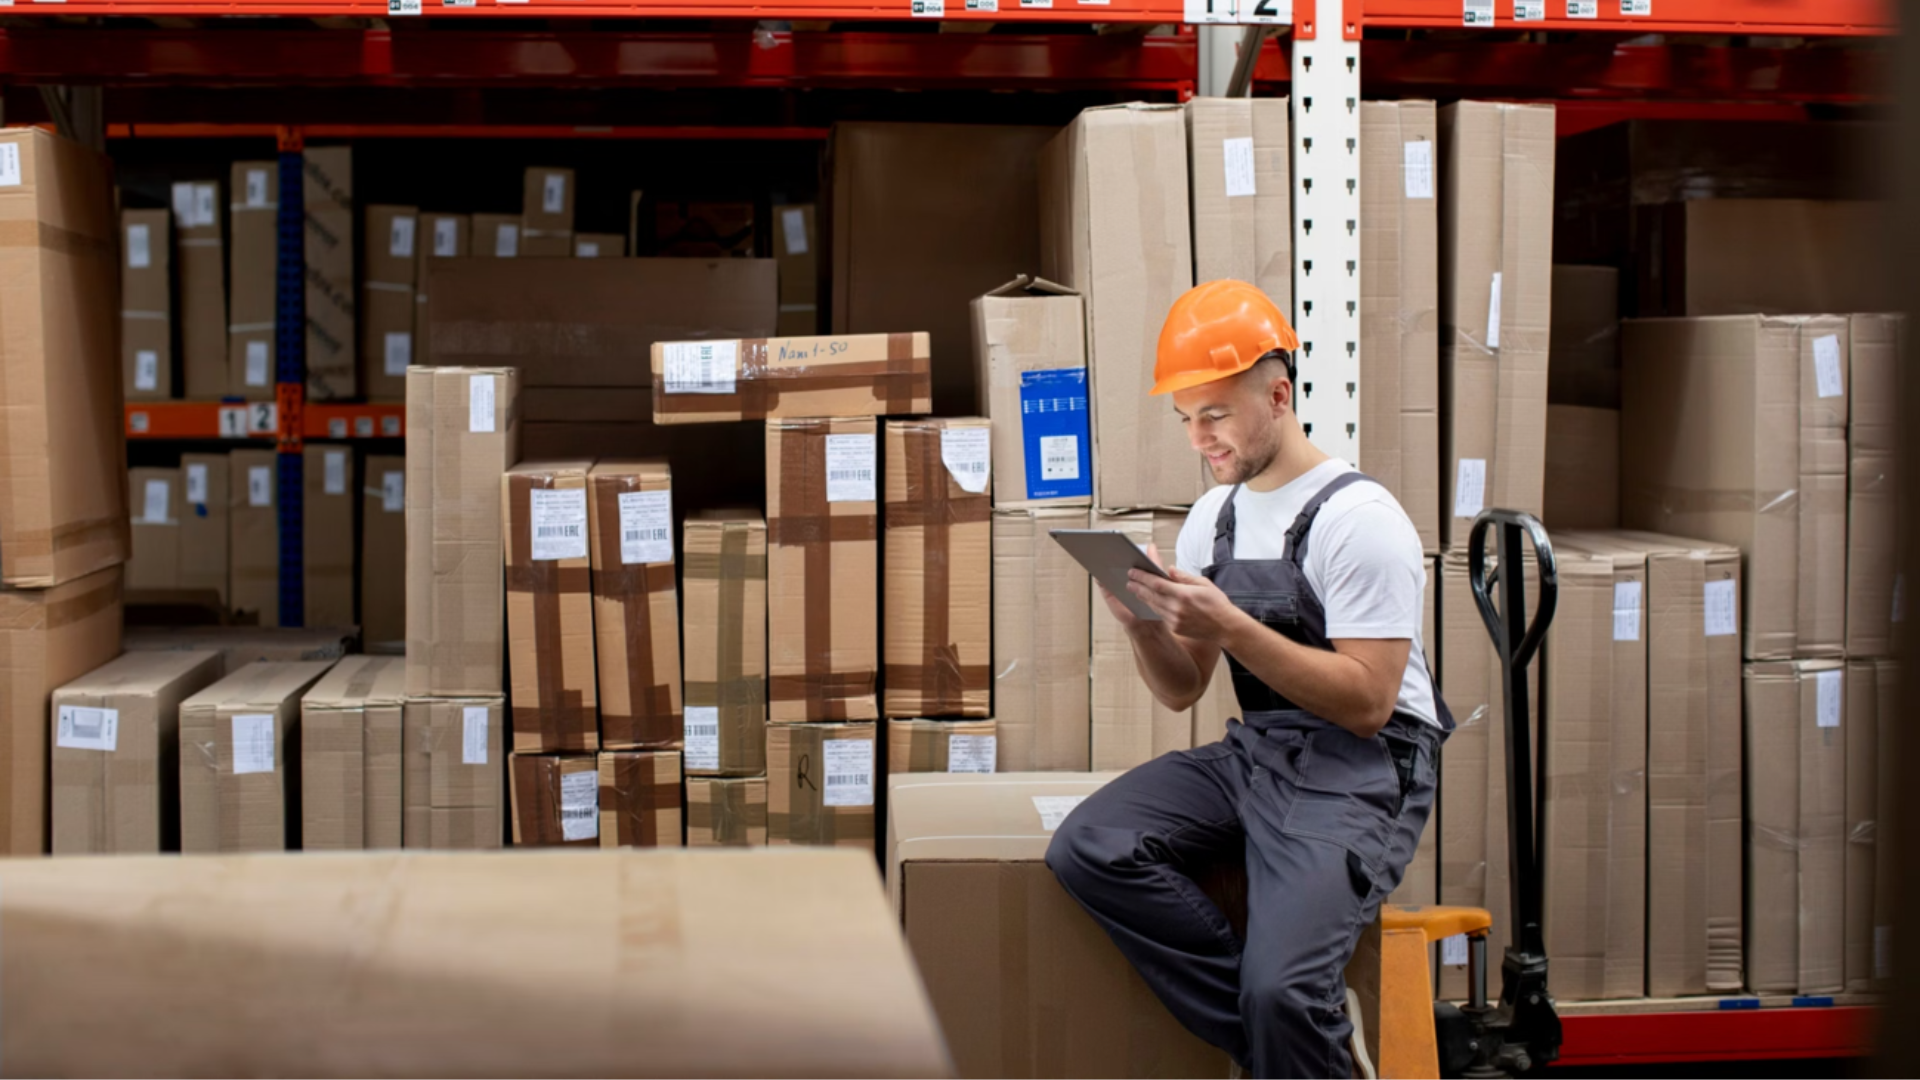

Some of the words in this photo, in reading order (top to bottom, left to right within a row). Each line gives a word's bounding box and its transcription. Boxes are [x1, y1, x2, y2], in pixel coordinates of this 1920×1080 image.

[256, 403, 271, 430] 2
[564, 525, 579, 537] EAC
[652, 528, 668, 540] EAC
